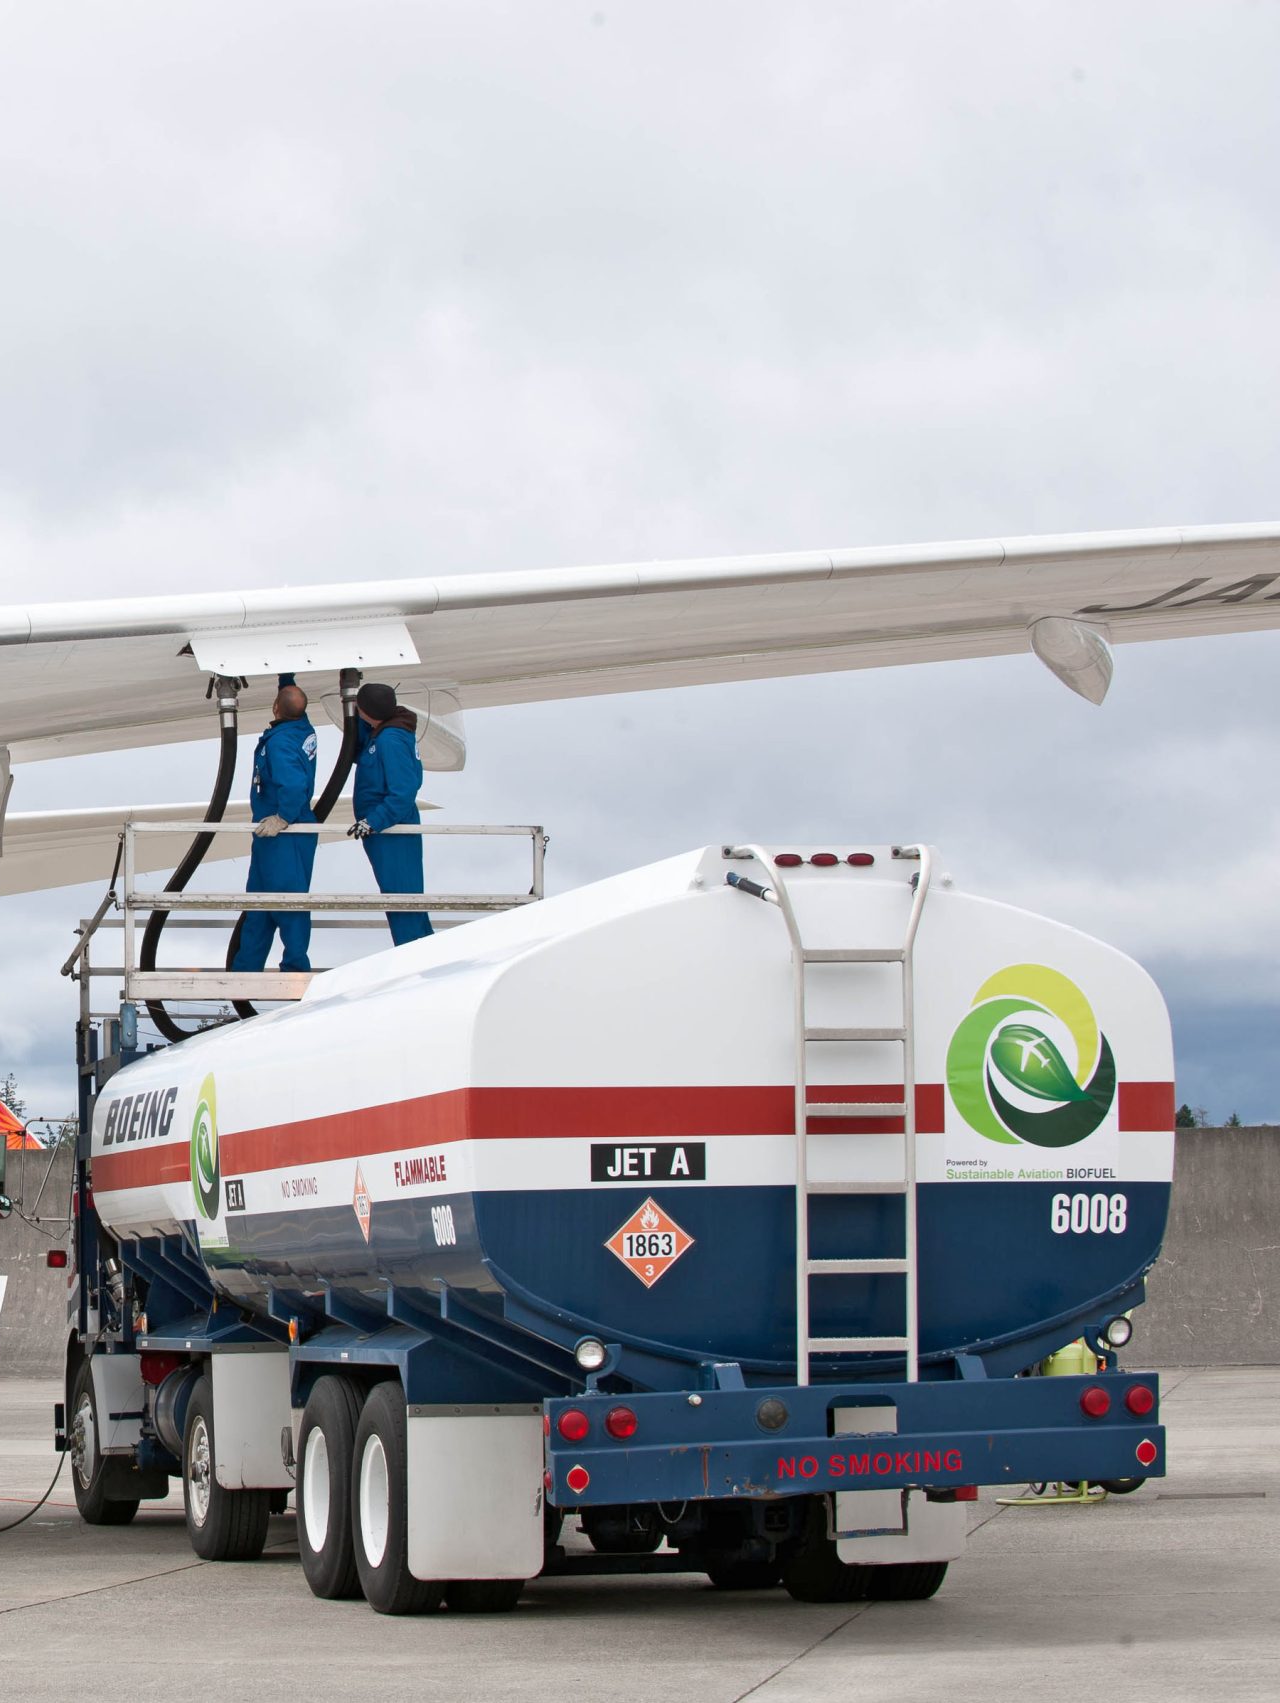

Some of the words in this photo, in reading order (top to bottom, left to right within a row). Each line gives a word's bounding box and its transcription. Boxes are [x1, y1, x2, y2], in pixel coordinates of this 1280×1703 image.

[1072, 572, 1280, 614] JA
[103, 1086, 179, 1146] BOEING
[394, 1155, 447, 1187] FLAMMABLE
[607, 1148, 656, 1177] JET
[670, 1147, 690, 1175] A
[946, 1168, 1015, 1180] Sustainable
[1017, 1168, 1063, 1180] Aviation
[1066, 1168, 1116, 1179] BIOFUEL
[979, 1159, 988, 1168] by
[281, 1180, 291, 1199] NO
[292, 1177, 318, 1197] SMOKING
[431, 1204, 457, 1246] 6008
[1051, 1193, 1127, 1234] 6008
[626, 1233, 673, 1257] 1863
[645, 1264, 655, 1277] 3
[777, 1455, 819, 1480] NO
[828, 1449, 963, 1477] SMOKING
